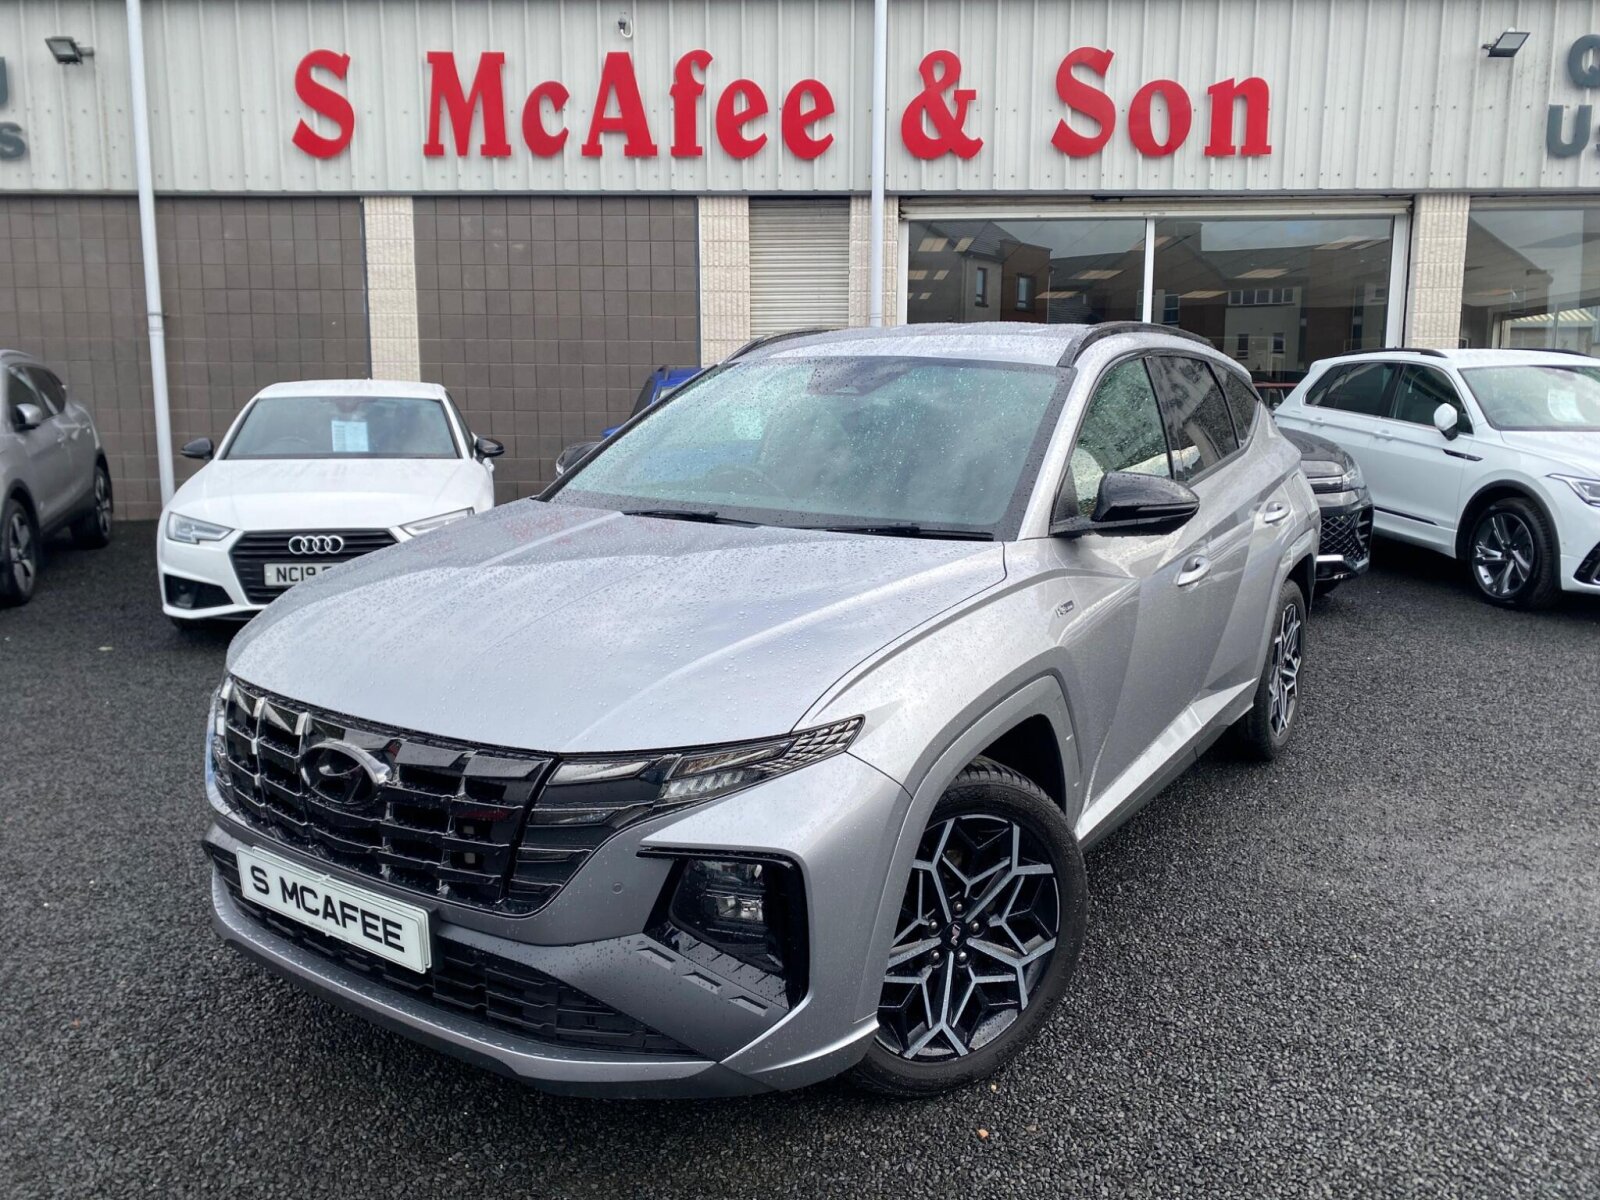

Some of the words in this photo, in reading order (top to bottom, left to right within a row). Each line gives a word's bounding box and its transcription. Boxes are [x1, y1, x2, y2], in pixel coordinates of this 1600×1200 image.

[293, 50, 354, 158] S
[424, 50, 835, 159] McAfee
[901, 50, 983, 159] &
[1052, 47, 1272, 157] Son
[250, 865, 270, 895] S
[279, 876, 405, 953] MCAFEE
